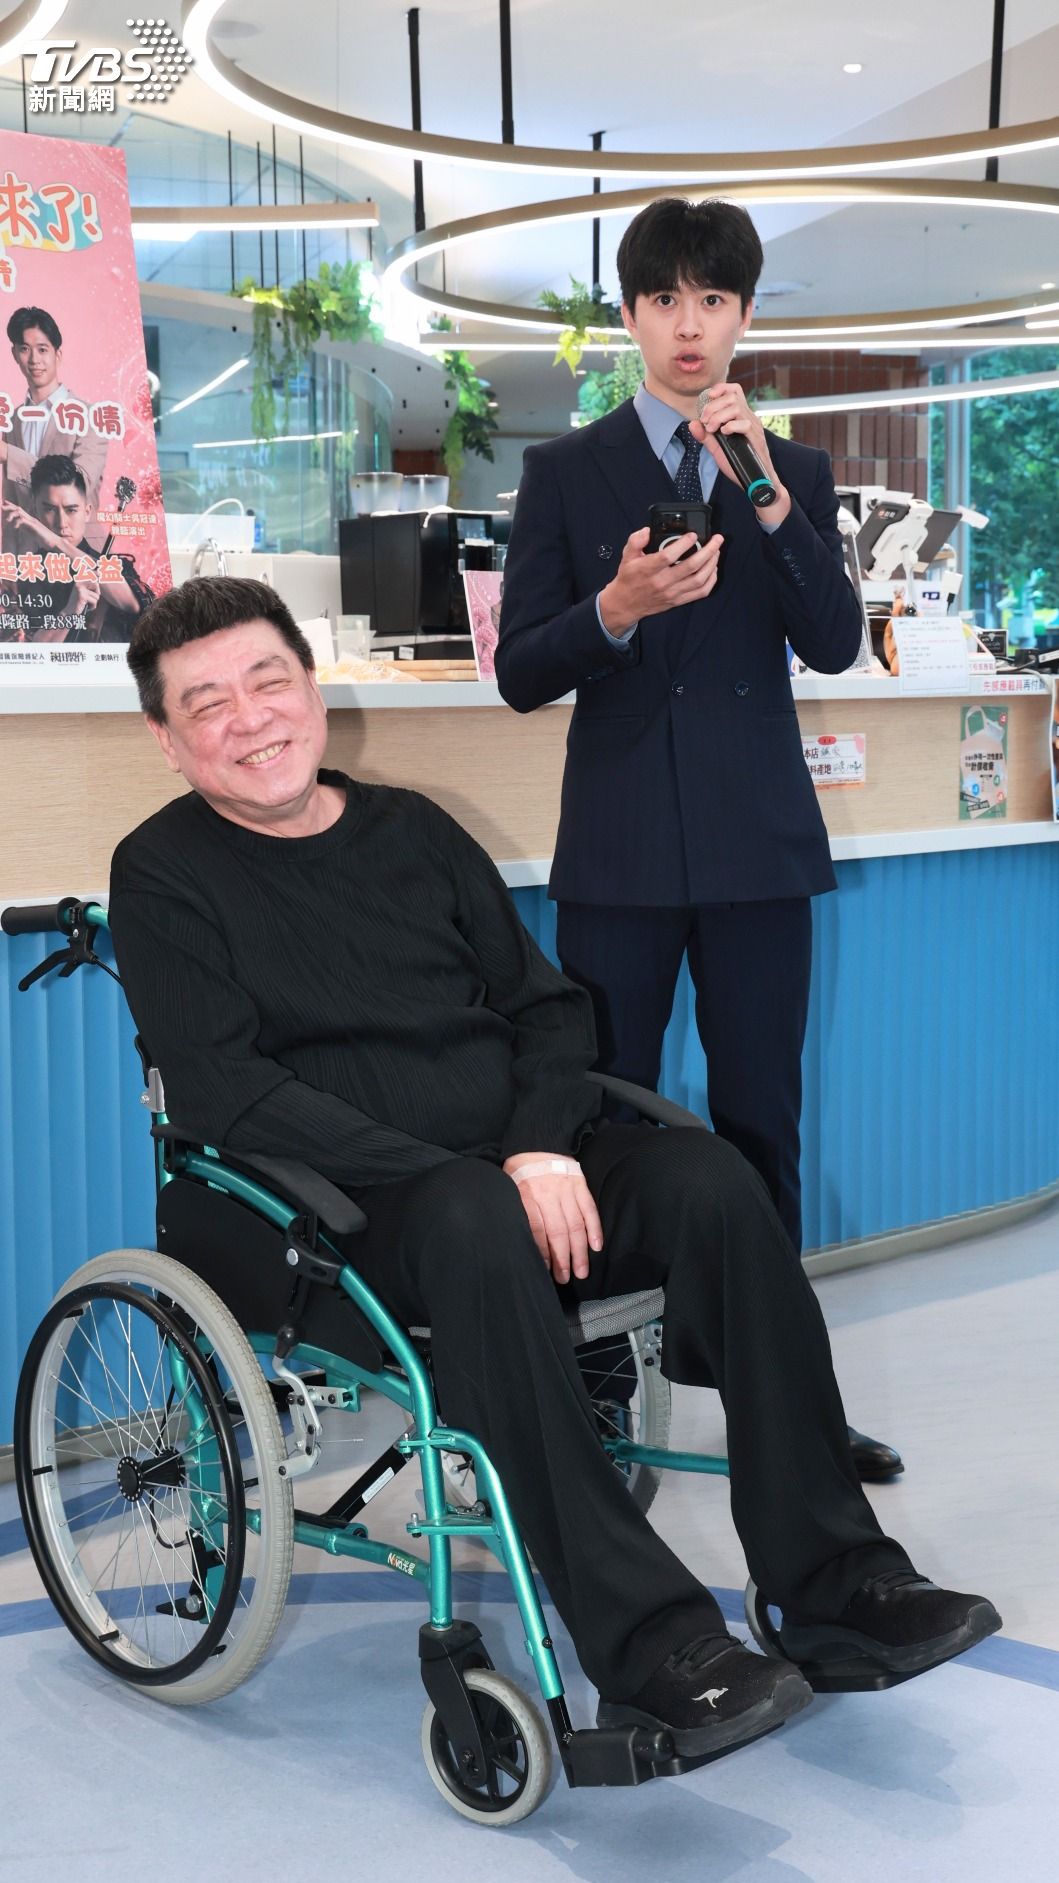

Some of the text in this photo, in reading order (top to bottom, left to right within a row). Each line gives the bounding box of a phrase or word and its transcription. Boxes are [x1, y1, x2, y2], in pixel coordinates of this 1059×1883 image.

[0, 173, 100, 246] 來了!
[0, 614, 88, 631] 隆路二段88號
[804, 747, 819, 760] 本店
